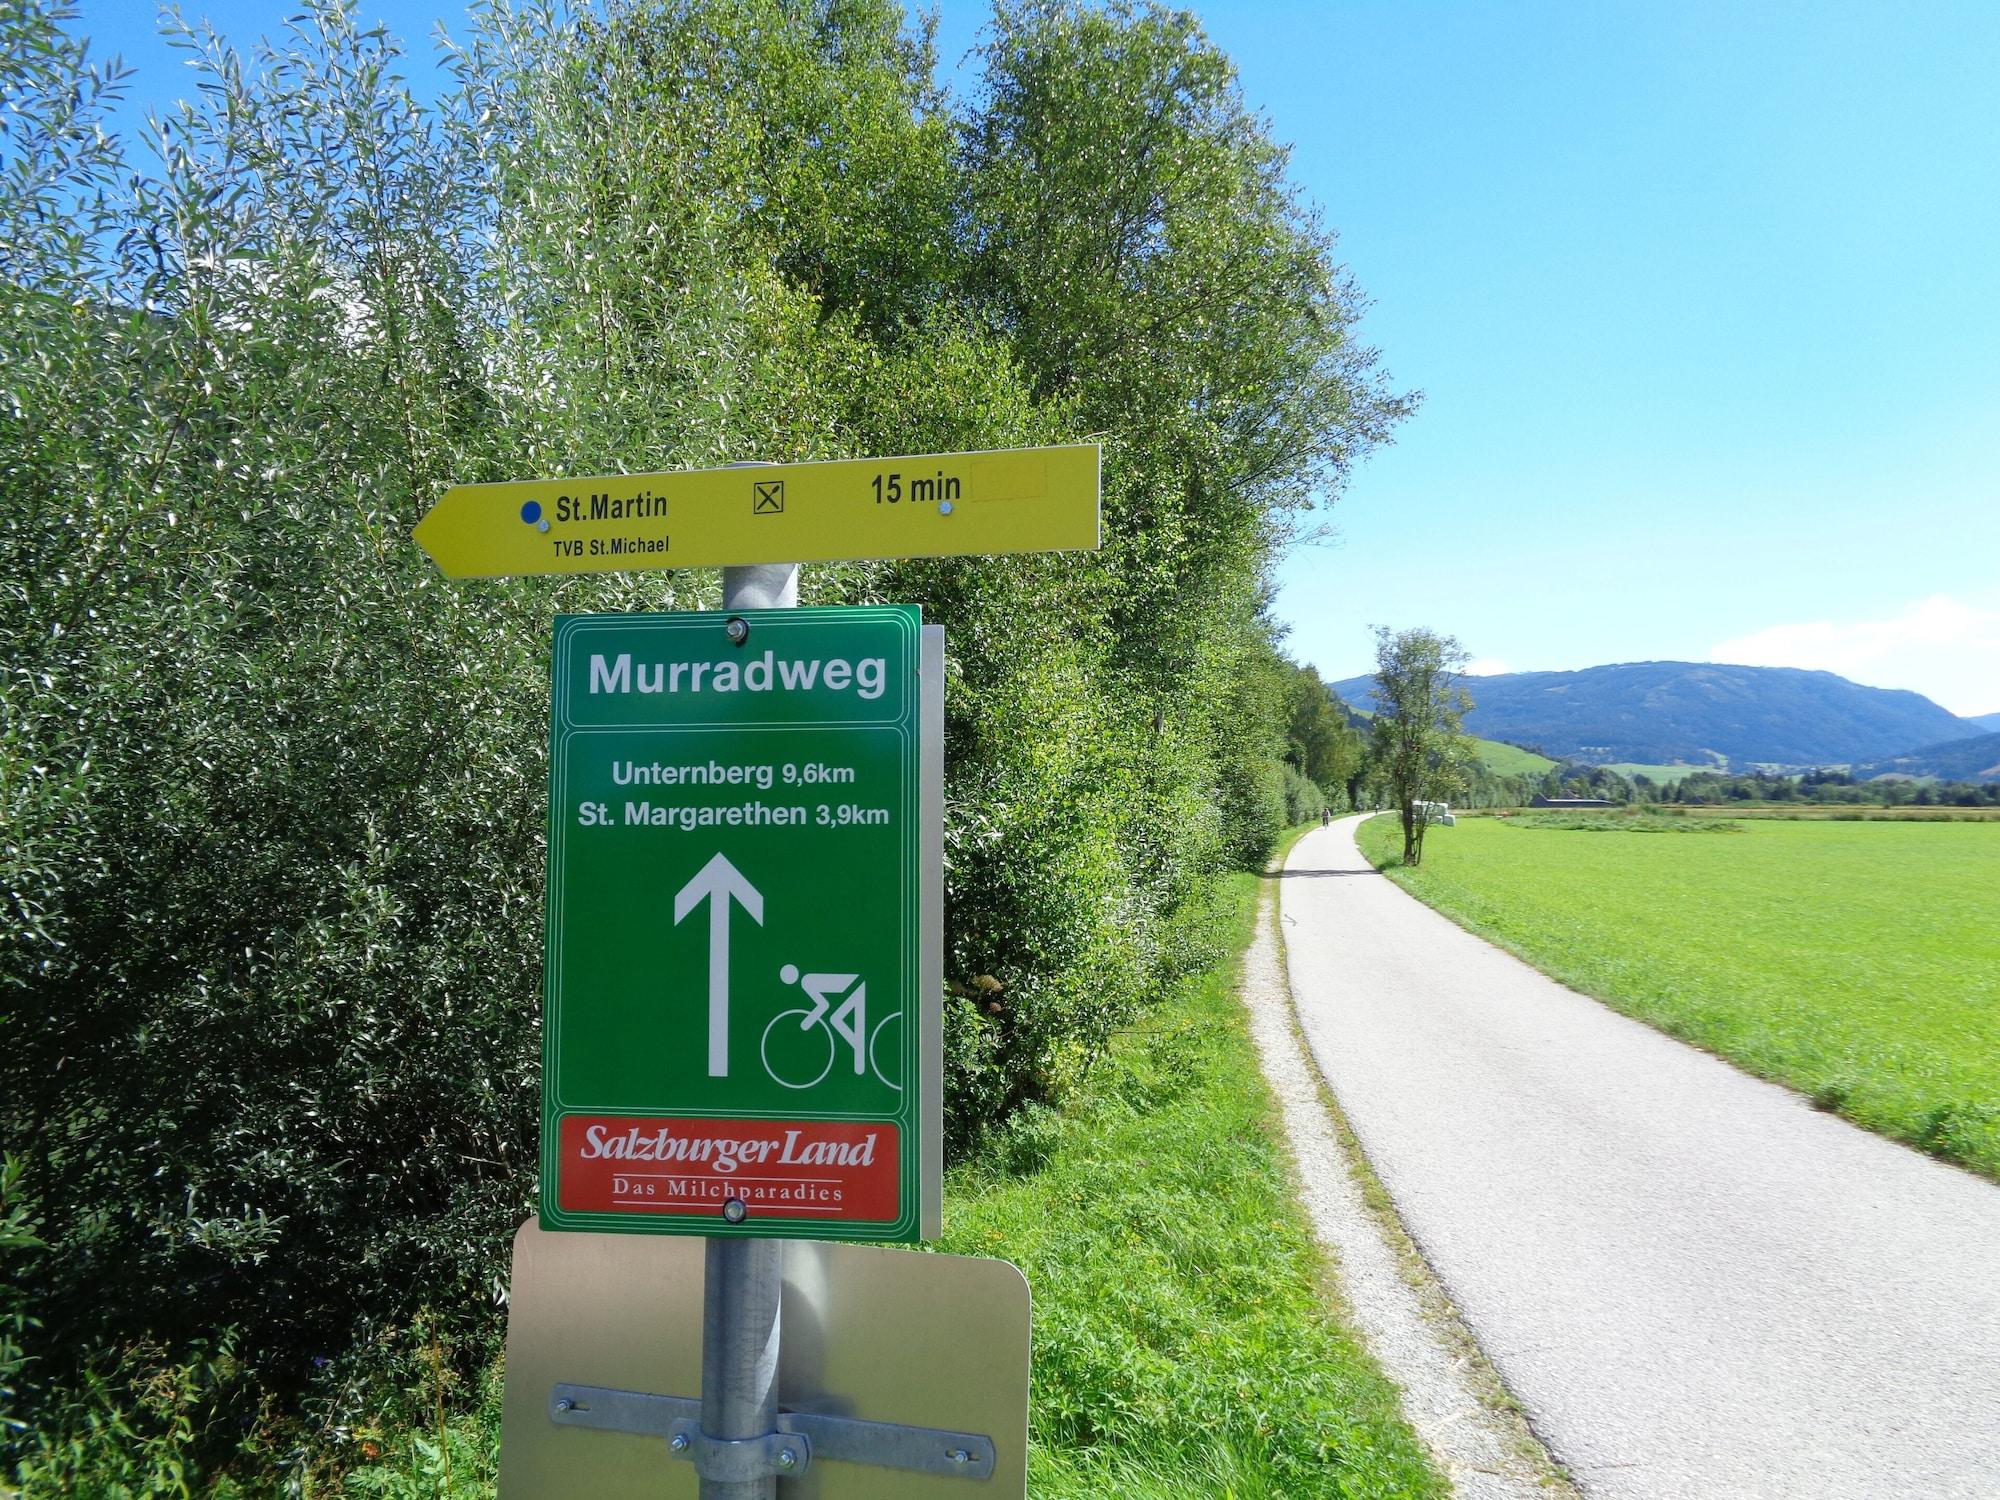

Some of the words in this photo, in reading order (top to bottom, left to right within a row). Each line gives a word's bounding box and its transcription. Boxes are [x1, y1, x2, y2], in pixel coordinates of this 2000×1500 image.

[871, 474, 901, 504] 15
[909, 470, 961, 502] min
[553, 540, 584, 557] TVB
[589, 650, 886, 699] Murradweg
[612, 760, 773, 789] Unternberg
[782, 763, 855, 787] 9,6km
[578, 801, 614, 826] St.
[624, 801, 807, 831] Margarethen
[815, 804, 890, 829] 3,9km
[612, 1178, 655, 1195] Das
[668, 1179, 843, 1201] Milchparadies
